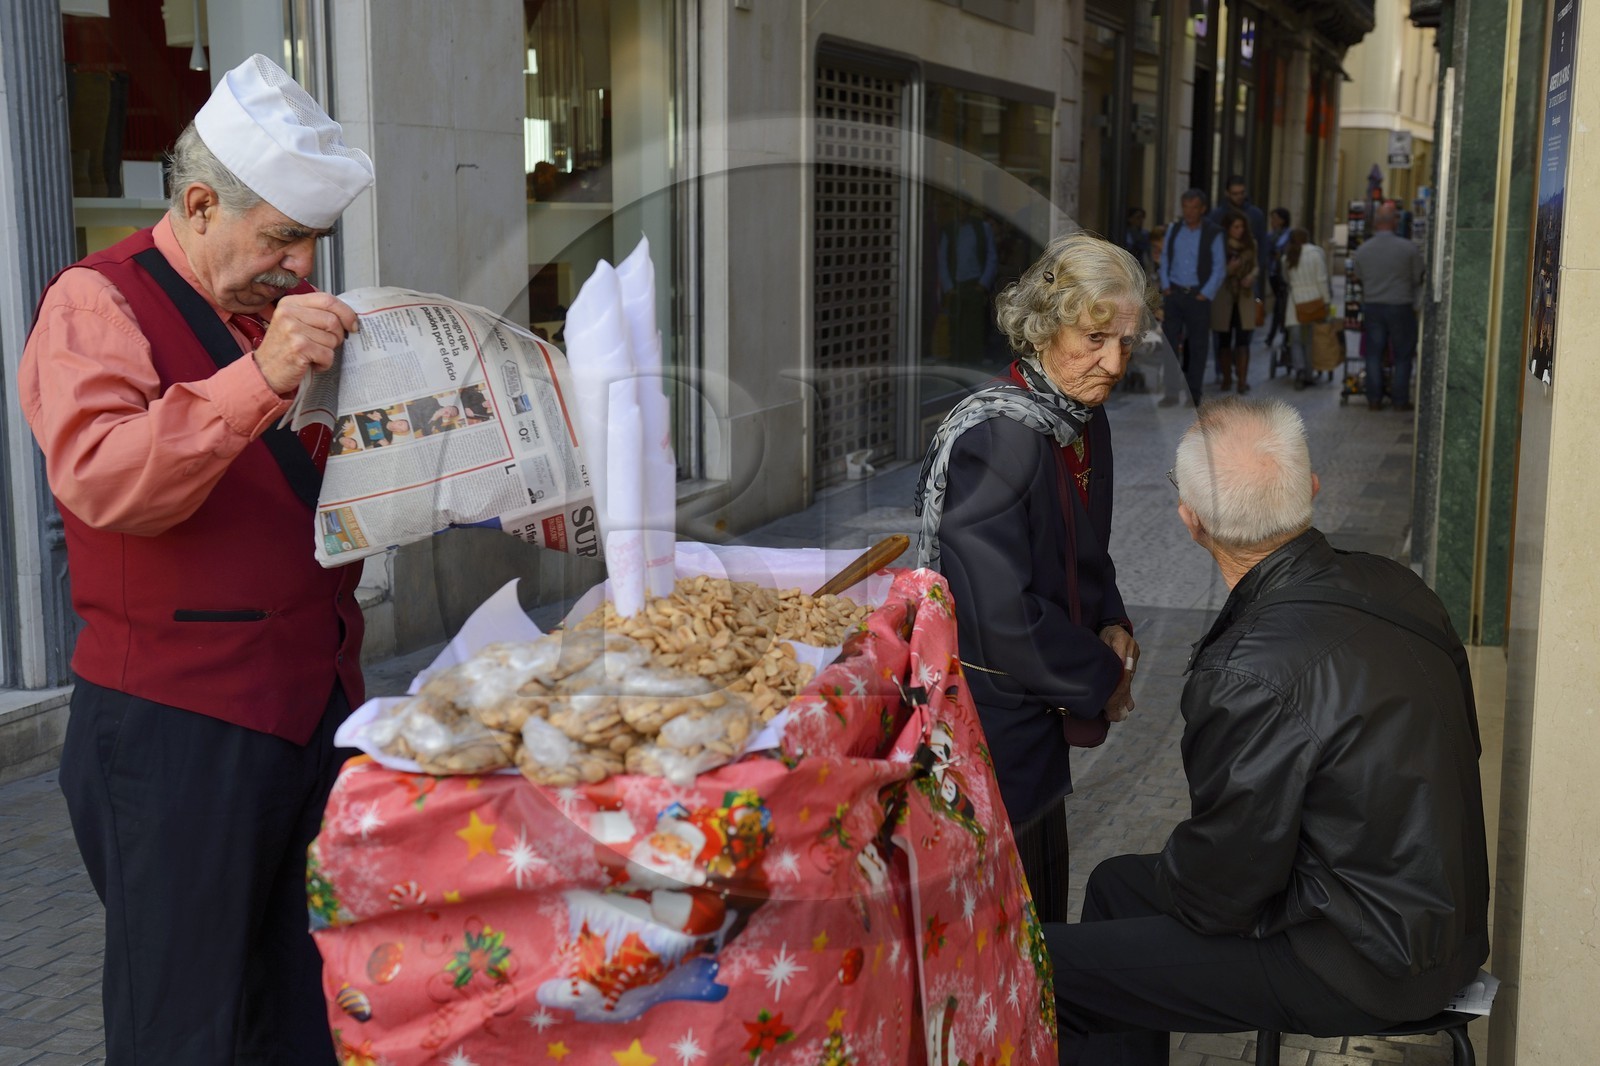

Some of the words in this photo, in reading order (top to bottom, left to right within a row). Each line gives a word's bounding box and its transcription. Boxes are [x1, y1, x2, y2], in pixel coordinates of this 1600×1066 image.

[419, 306, 438, 330] pasión
[432, 306, 447, 322] tiene
[442, 322, 456, 346] truco:
[451, 347, 459, 356] la
[432, 330, 444, 346] por
[448, 313, 463, 333] mago
[457, 333, 470, 351] que
[440, 347, 448, 355] el
[442, 356, 457, 381] oficio
[504, 463, 517, 475] L
[579, 464, 590, 487] SUR
[571, 505, 598, 557] SUR
